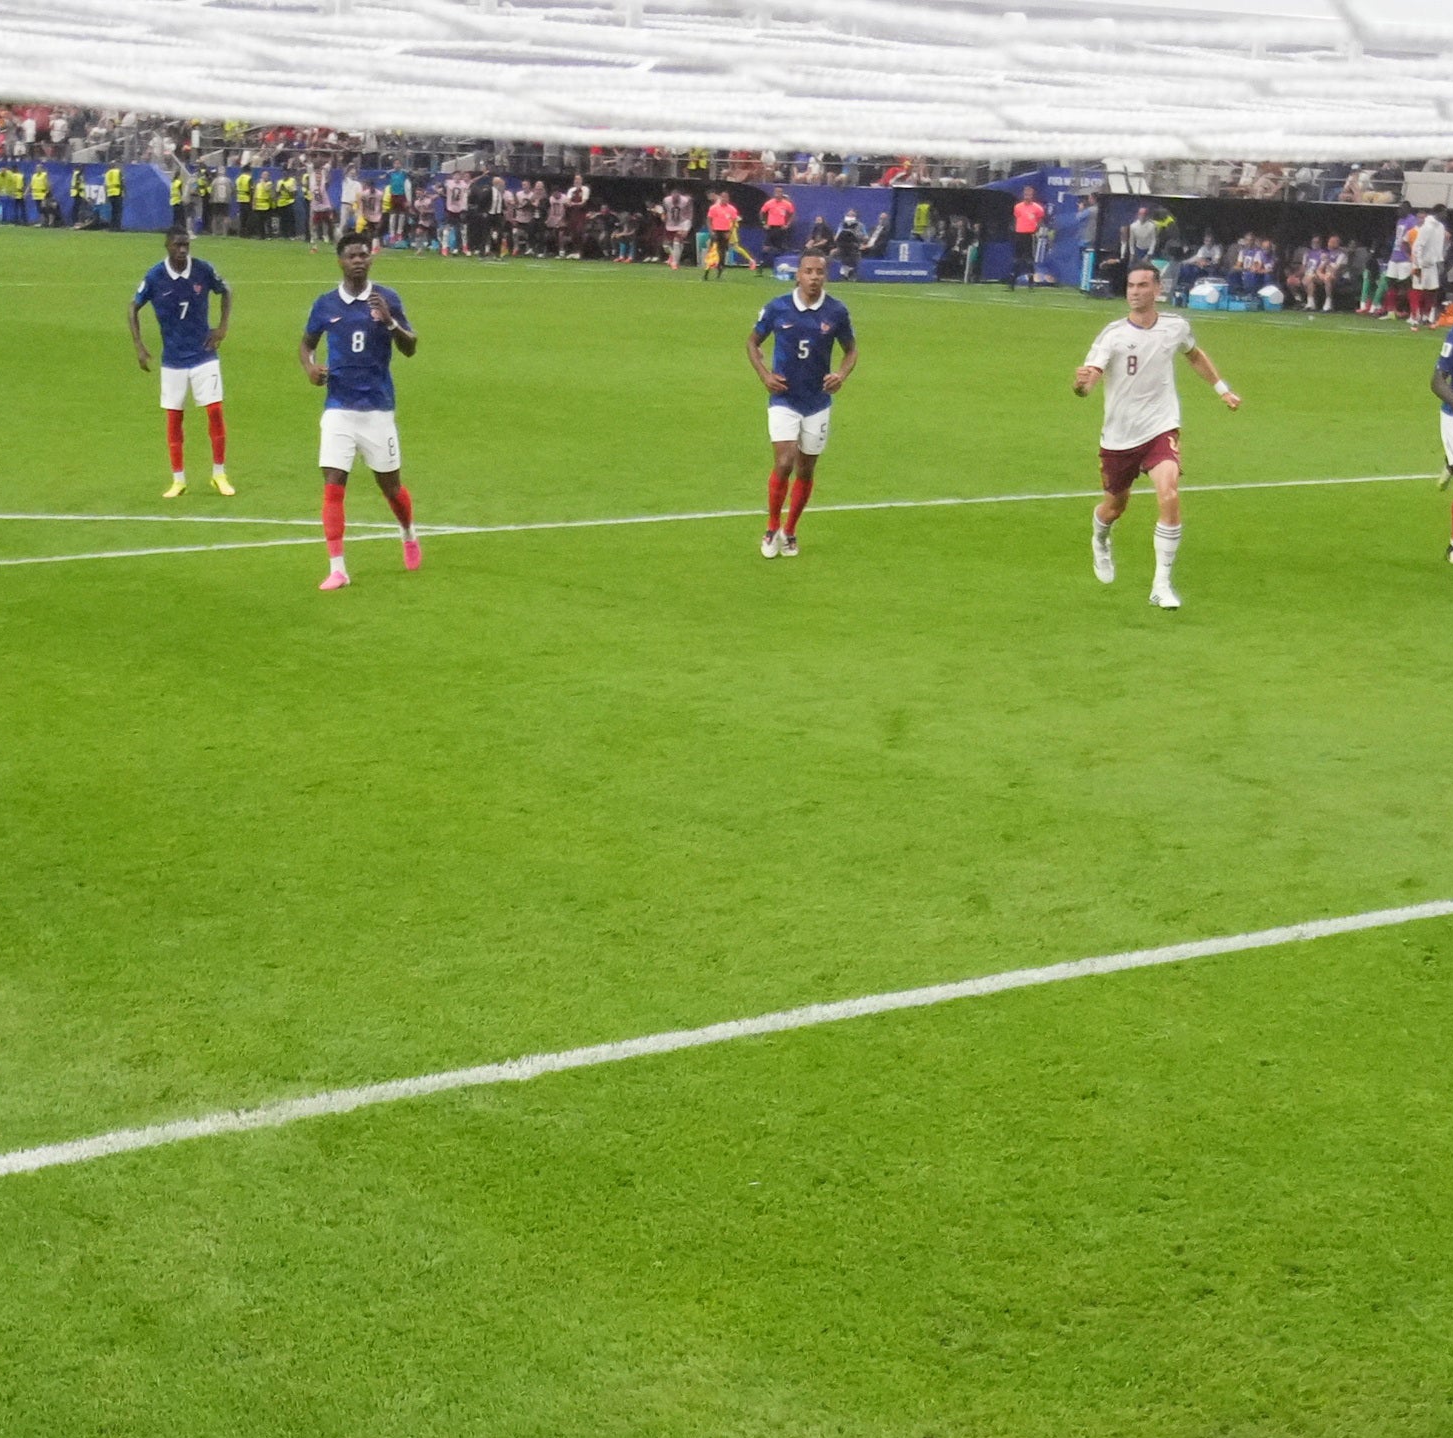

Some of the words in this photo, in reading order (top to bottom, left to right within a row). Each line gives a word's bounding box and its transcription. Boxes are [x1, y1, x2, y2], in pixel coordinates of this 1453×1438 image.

[179, 301, 190, 320] 7
[351, 330, 365, 353] 8
[797, 339, 810, 360] 5
[1126, 355, 1138, 376] 8
[211, 374, 219, 391] 7
